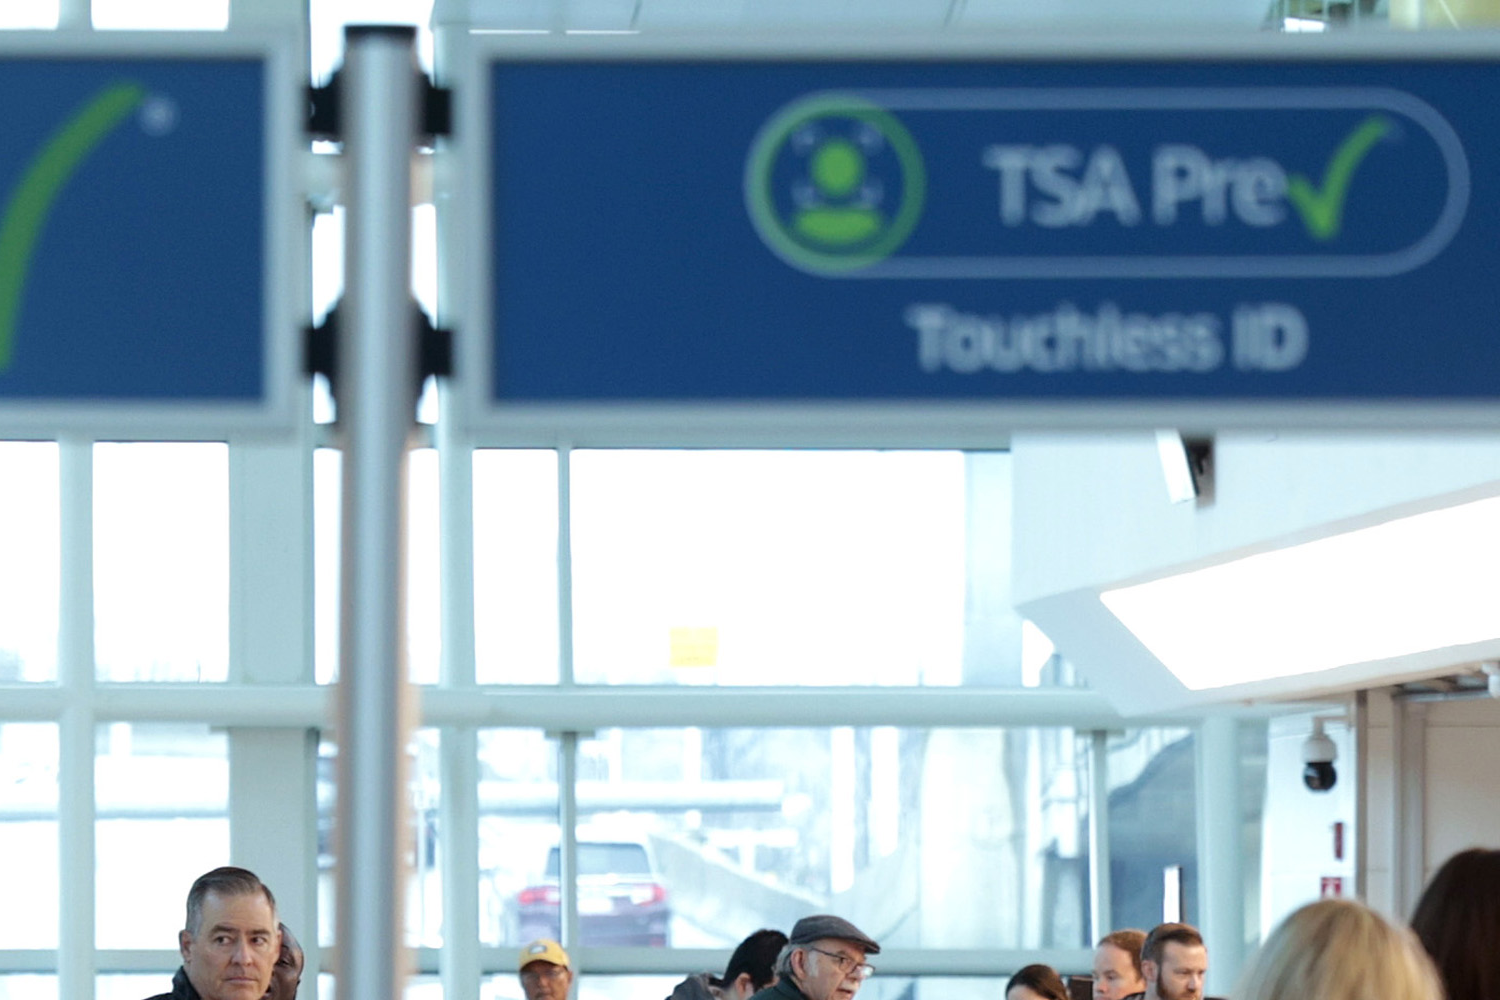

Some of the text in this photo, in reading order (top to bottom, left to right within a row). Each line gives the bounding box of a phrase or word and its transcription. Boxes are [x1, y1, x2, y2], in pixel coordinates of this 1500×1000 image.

[982, 143, 1141, 228] TSA
[907, 301, 1308, 373] Touchless ID
